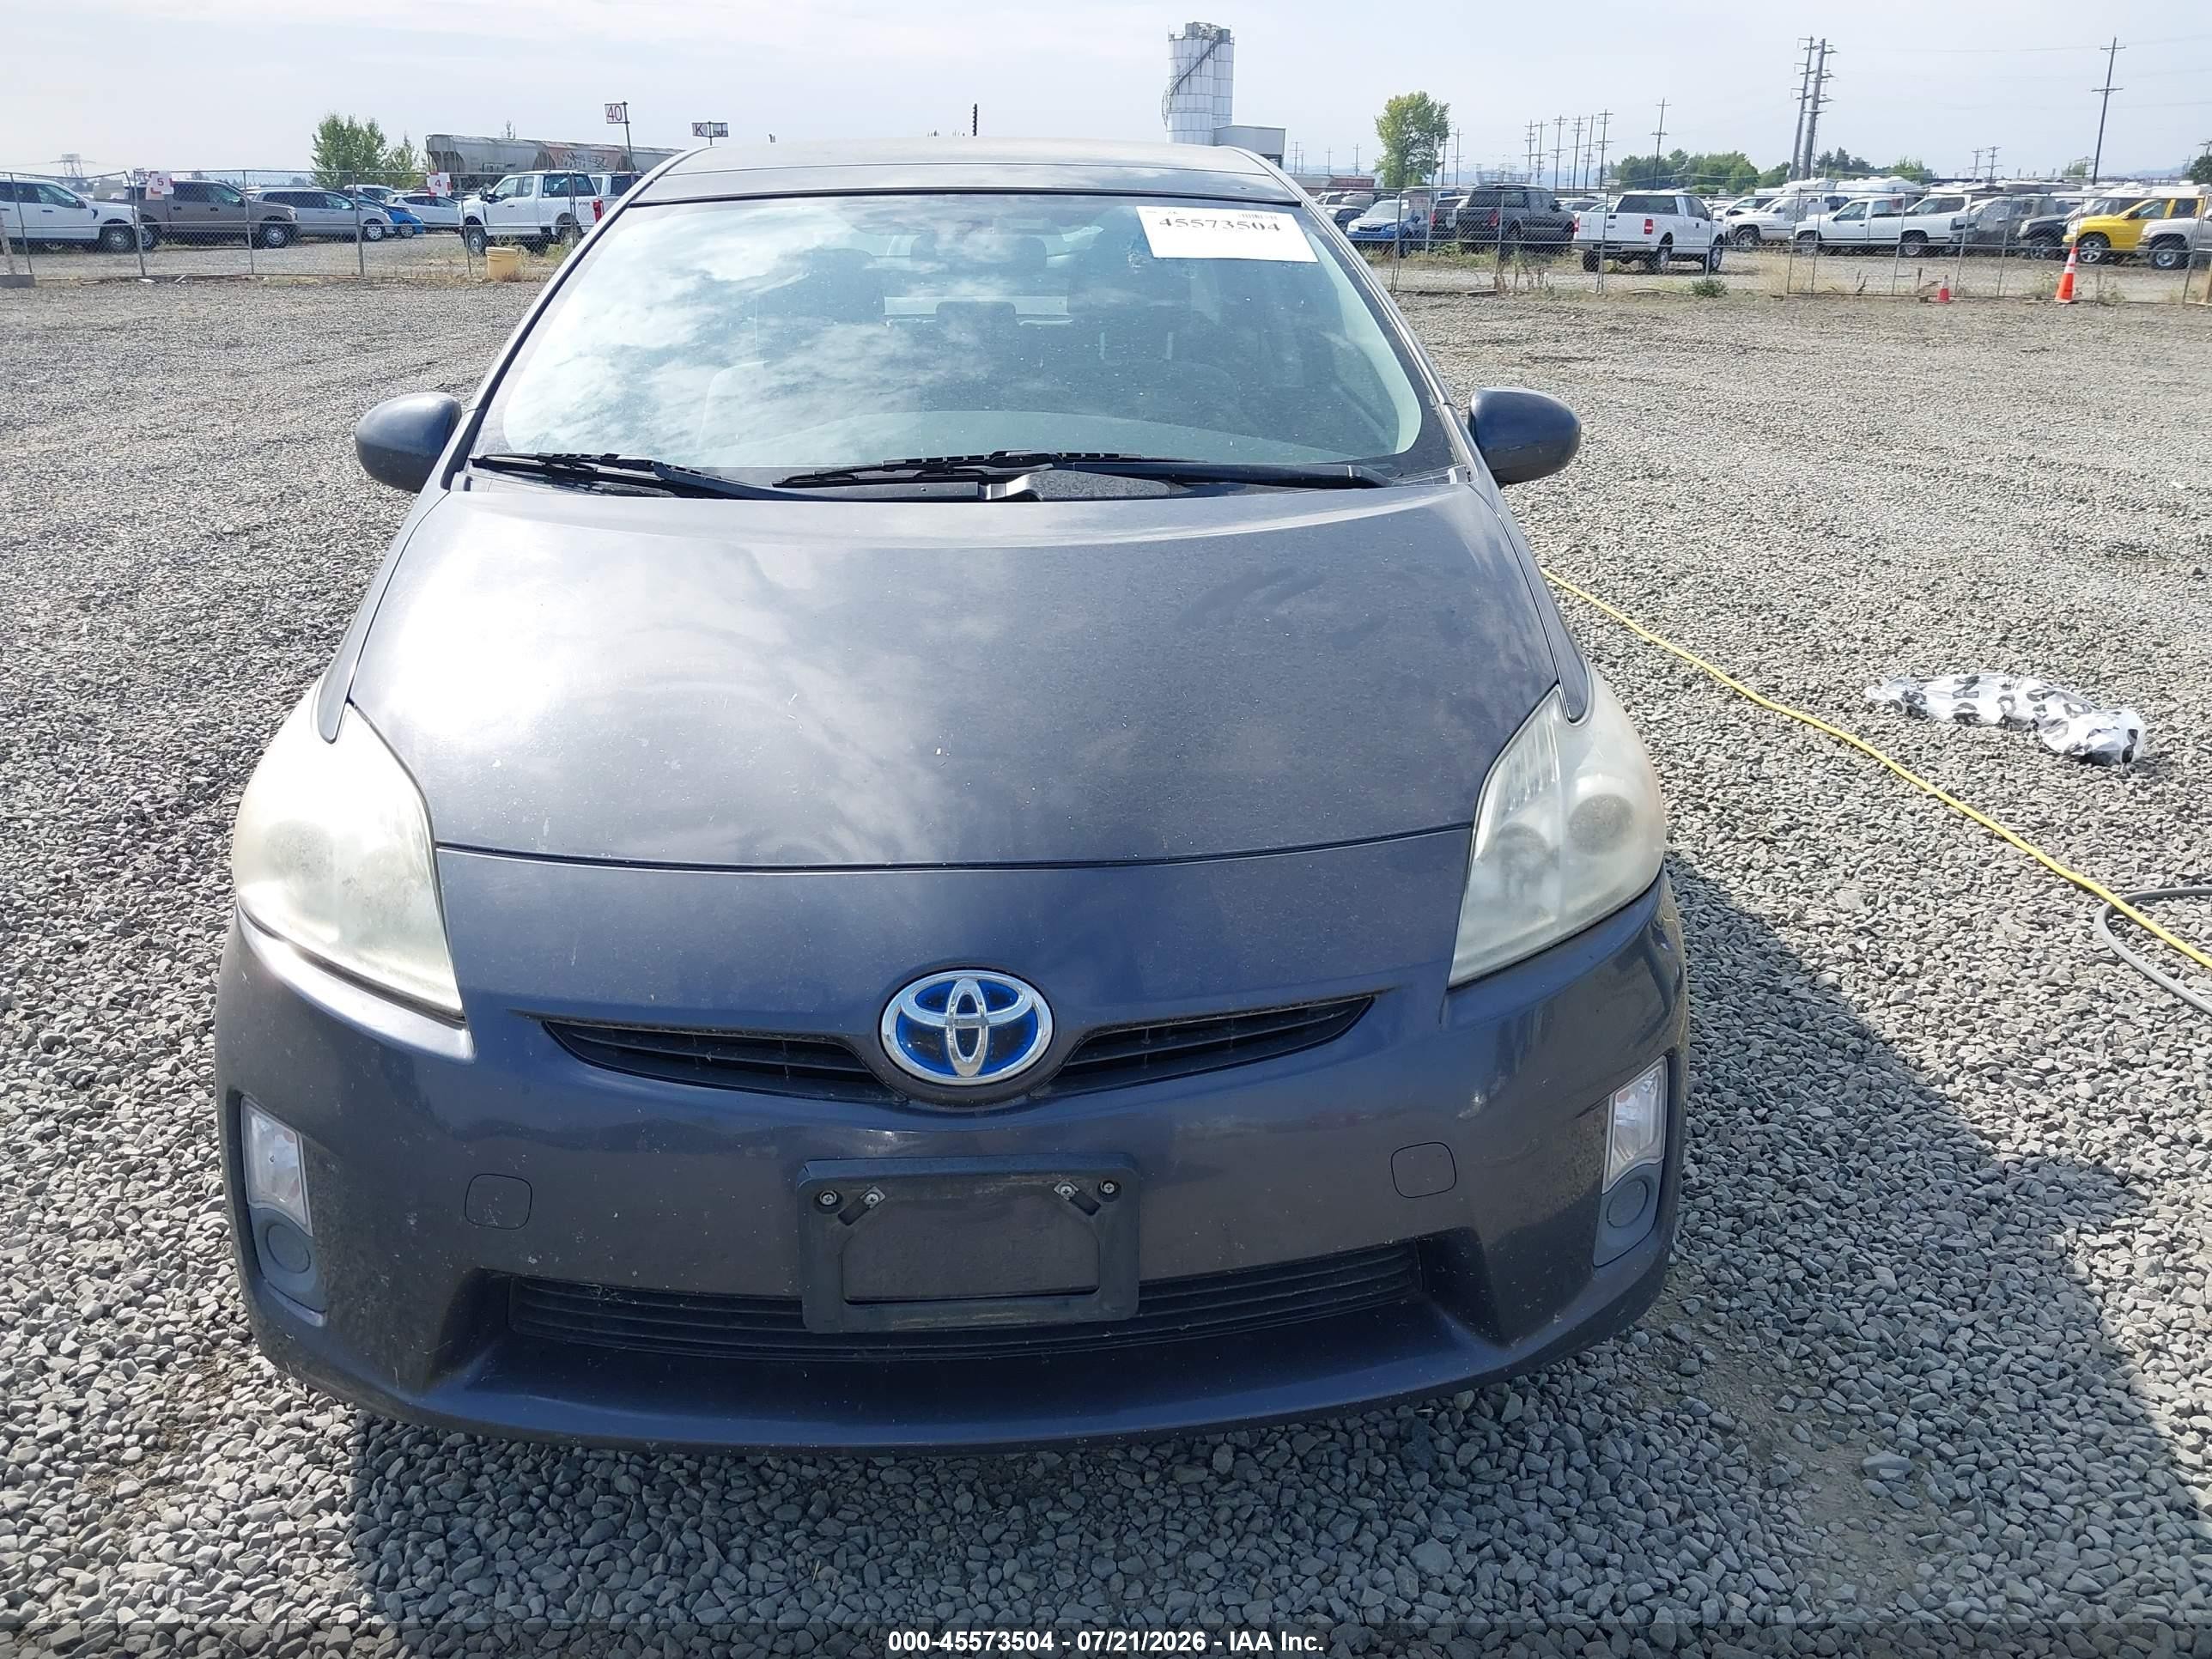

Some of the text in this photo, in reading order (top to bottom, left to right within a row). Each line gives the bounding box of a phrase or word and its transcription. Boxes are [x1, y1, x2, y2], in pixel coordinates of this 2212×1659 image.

[607, 105, 623, 121] 40
[695, 124, 704, 136] K
[157, 178, 164, 186] 5
[434, 179, 441, 187] 4
[1158, 217, 1280, 232] 45573504
